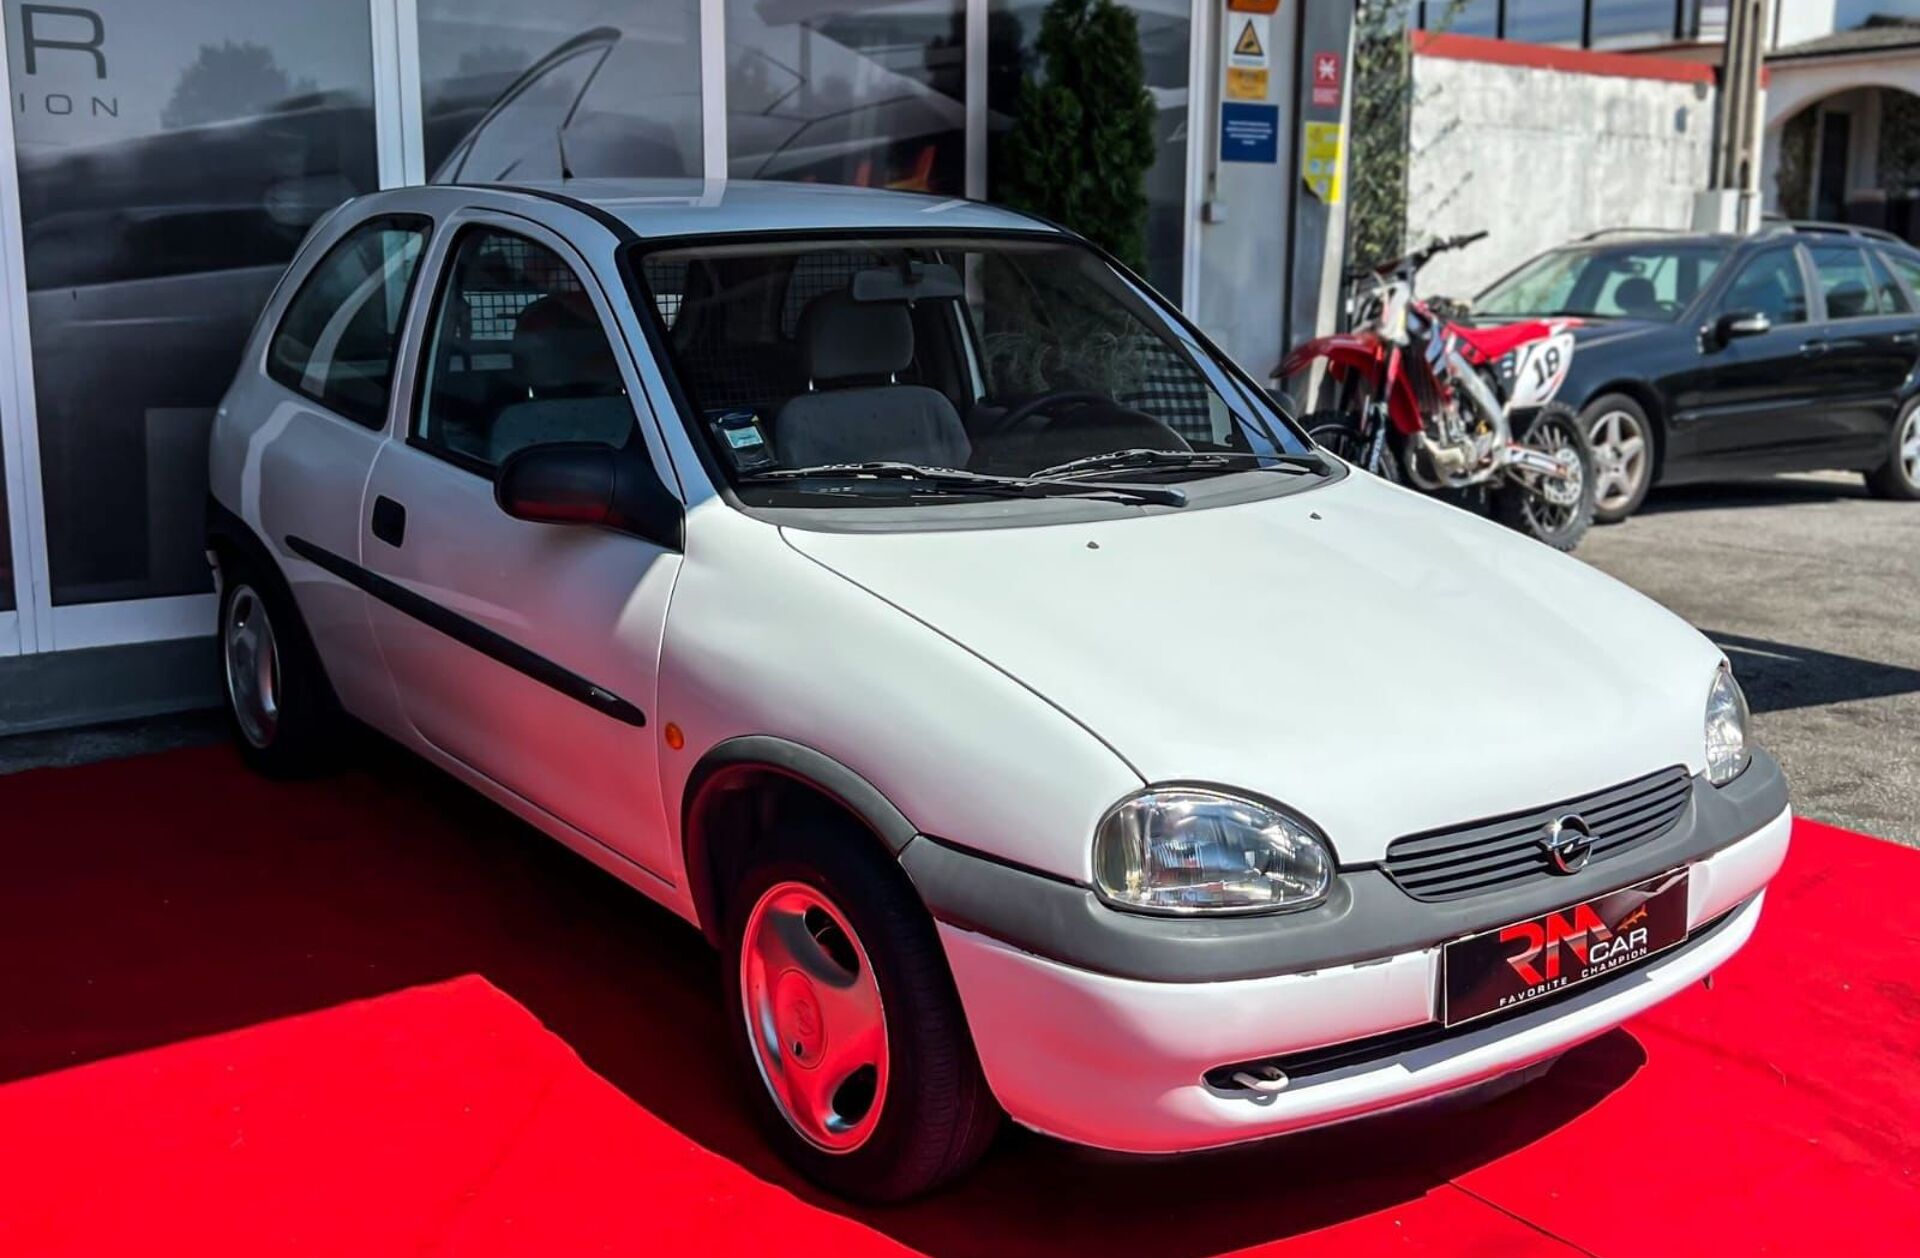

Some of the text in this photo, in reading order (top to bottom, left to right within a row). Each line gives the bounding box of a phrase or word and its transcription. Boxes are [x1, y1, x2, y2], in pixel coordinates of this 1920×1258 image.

[21, 4, 107, 79] R
[1533, 346, 1560, 390] 18
[1499, 947, 1648, 1007] FAVORITE CHAMPION
[1500, 903, 1648, 986] RM CAR
